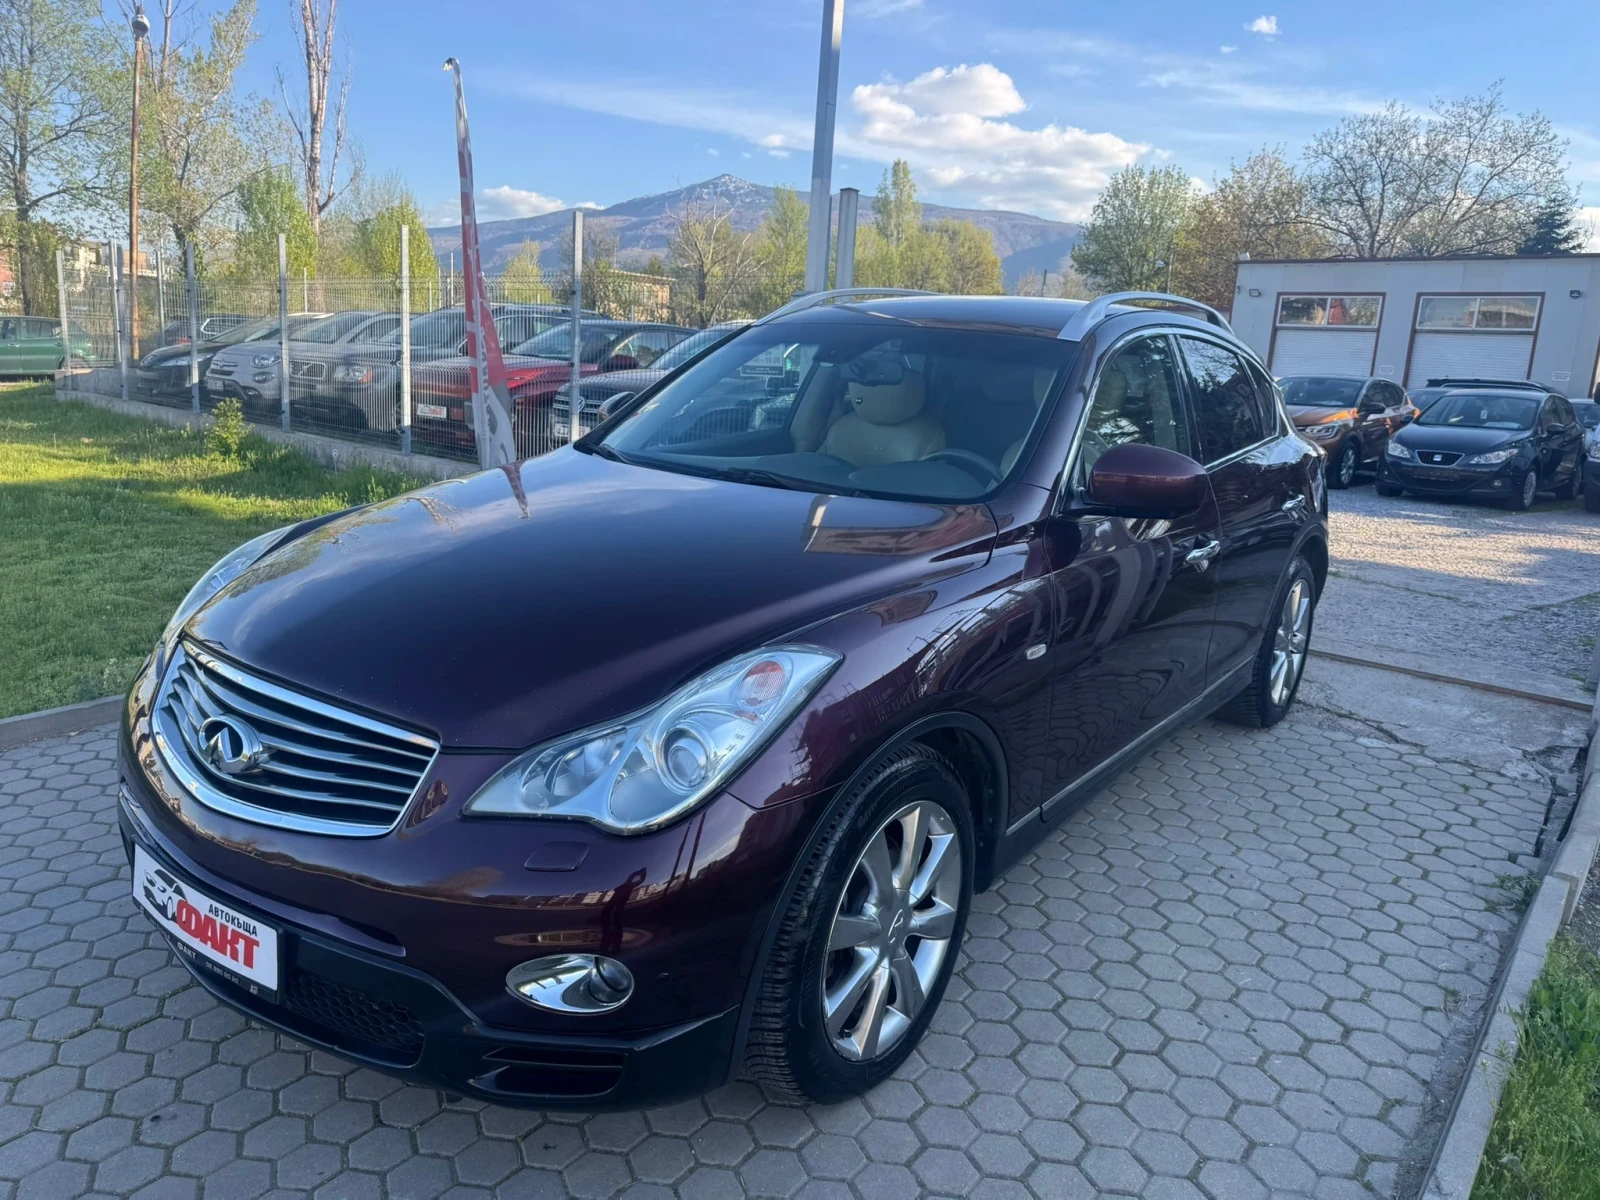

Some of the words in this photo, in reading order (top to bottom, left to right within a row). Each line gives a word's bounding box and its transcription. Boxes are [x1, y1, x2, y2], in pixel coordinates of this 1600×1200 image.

[177, 899, 260, 970] ФАКТ
[208, 904, 258, 937] АВТОКЪЩА
[177, 941, 197, 960] ФАКТ
